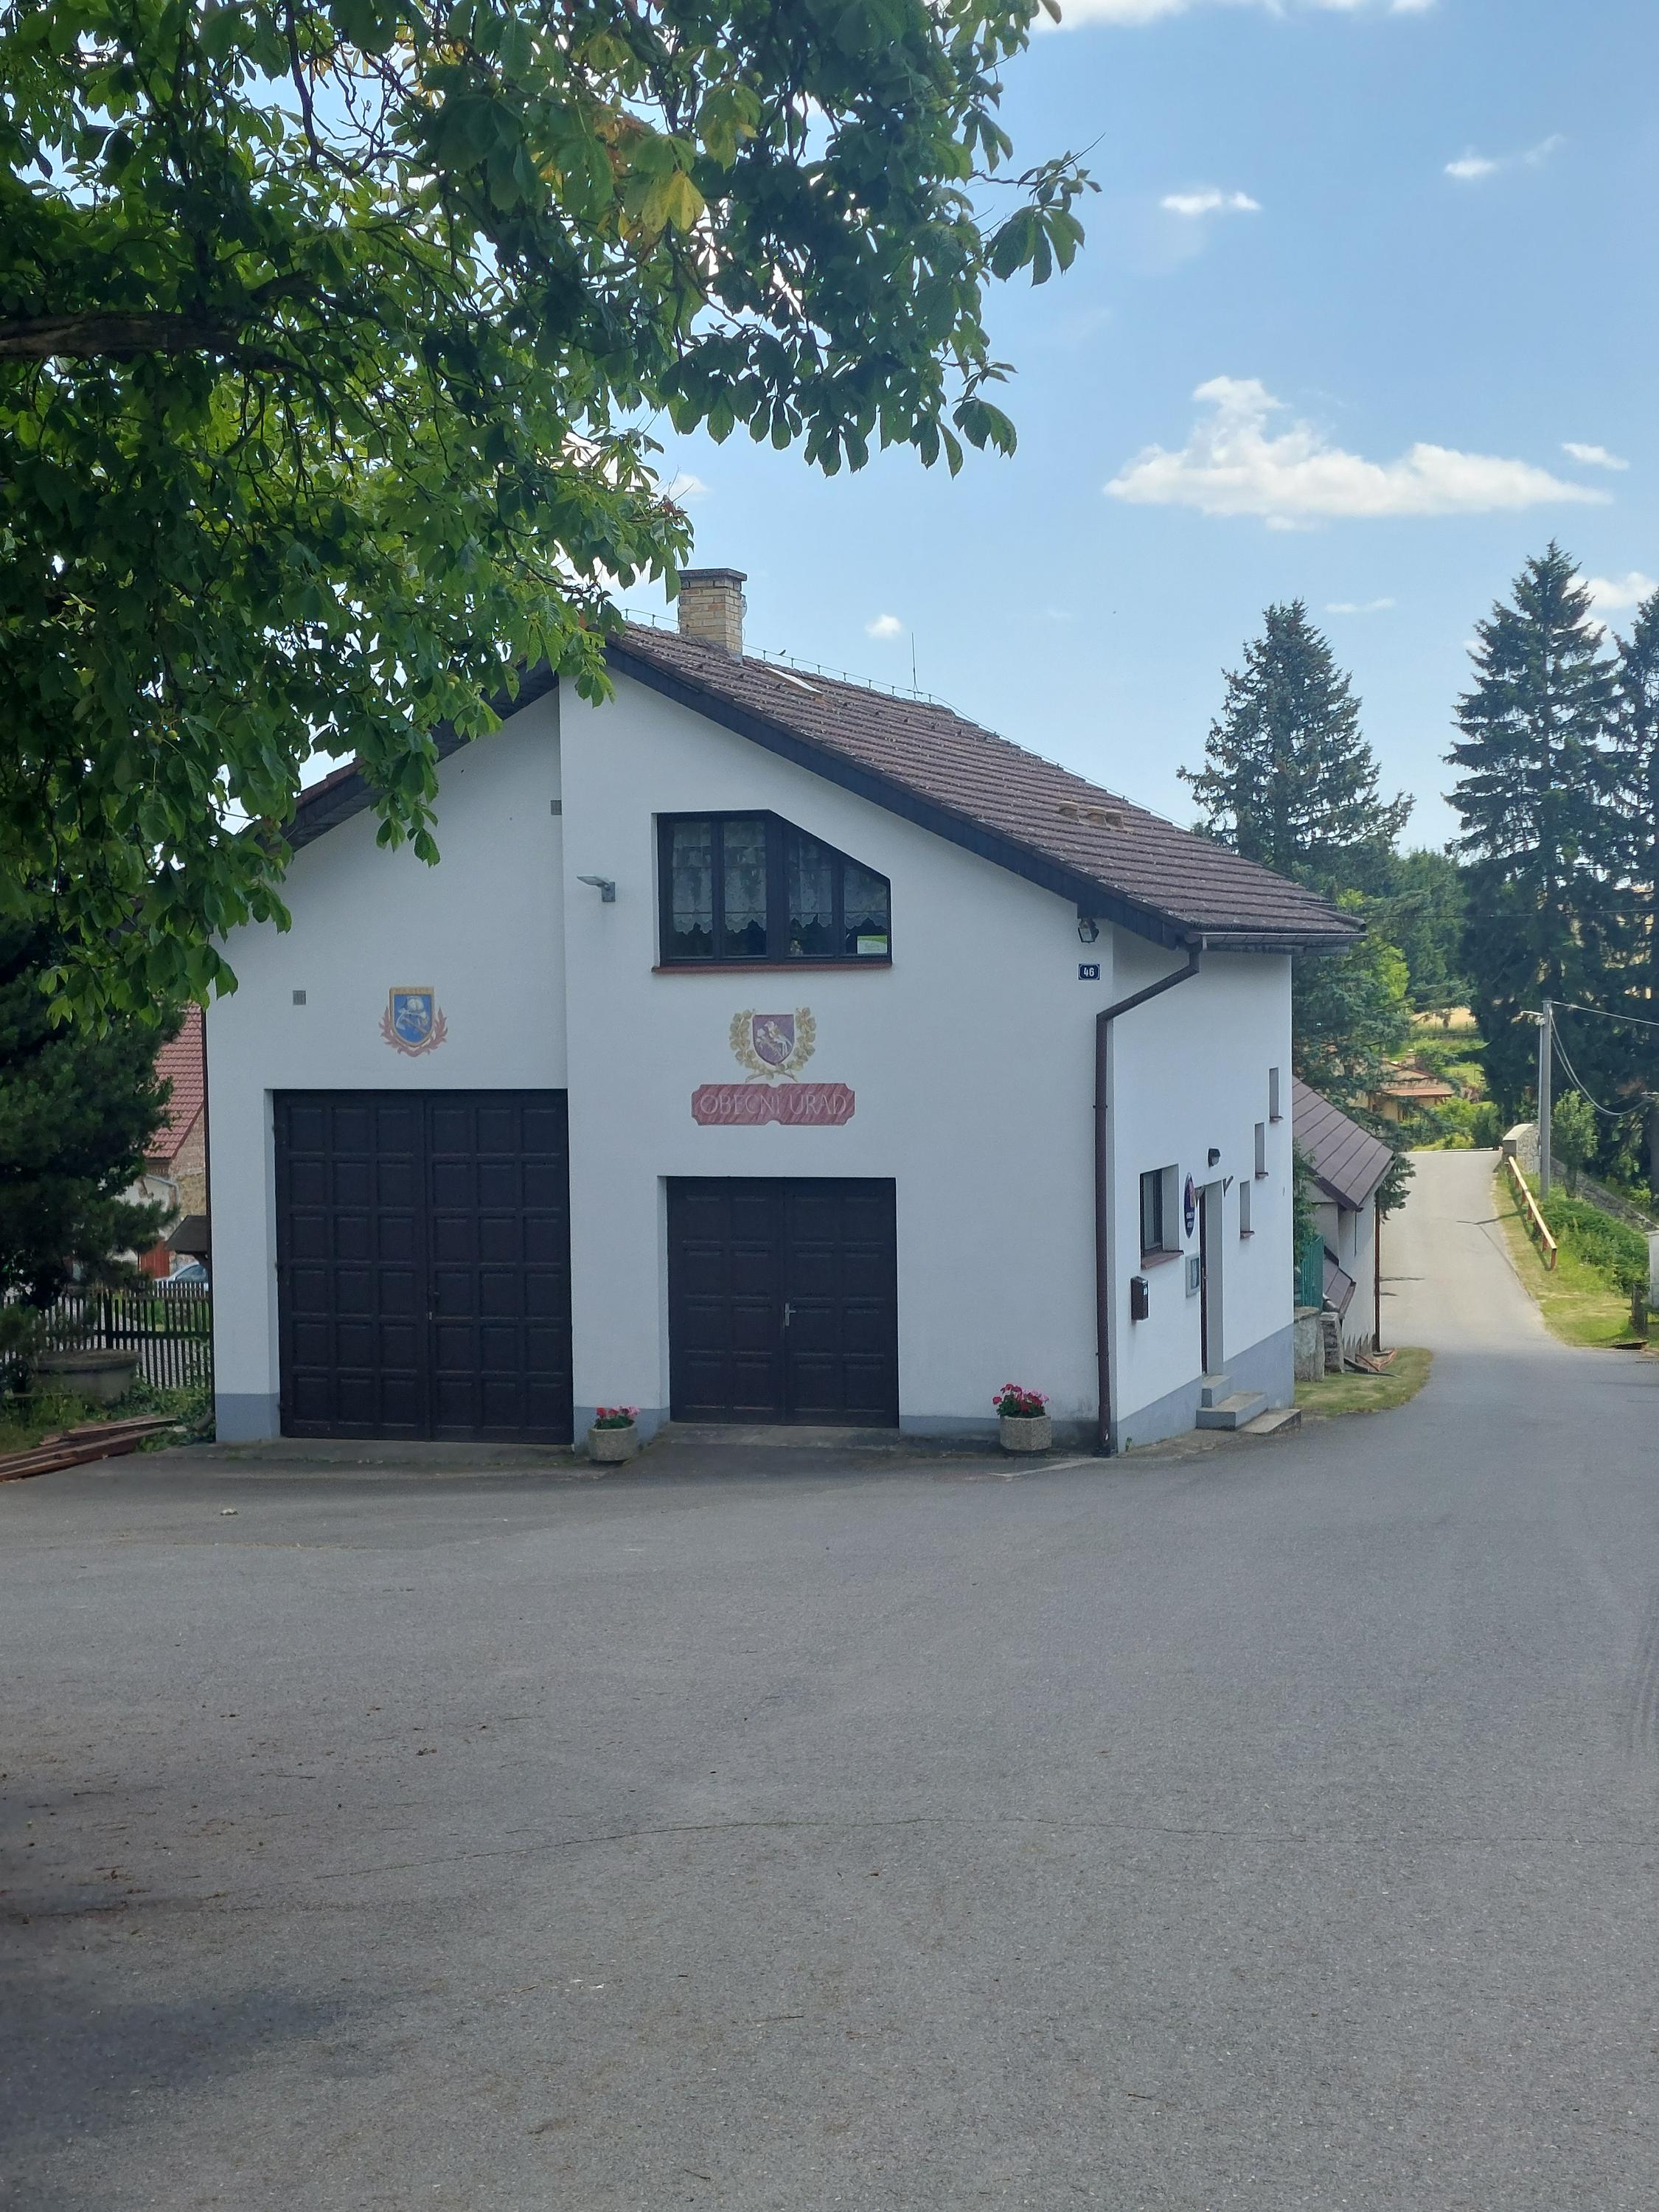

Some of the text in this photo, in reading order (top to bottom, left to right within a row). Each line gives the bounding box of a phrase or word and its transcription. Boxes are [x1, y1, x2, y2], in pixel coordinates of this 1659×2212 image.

[1083, 967, 1095, 977] 46
[700, 1089, 847, 1116] OBECNÍ ÚŘAD
